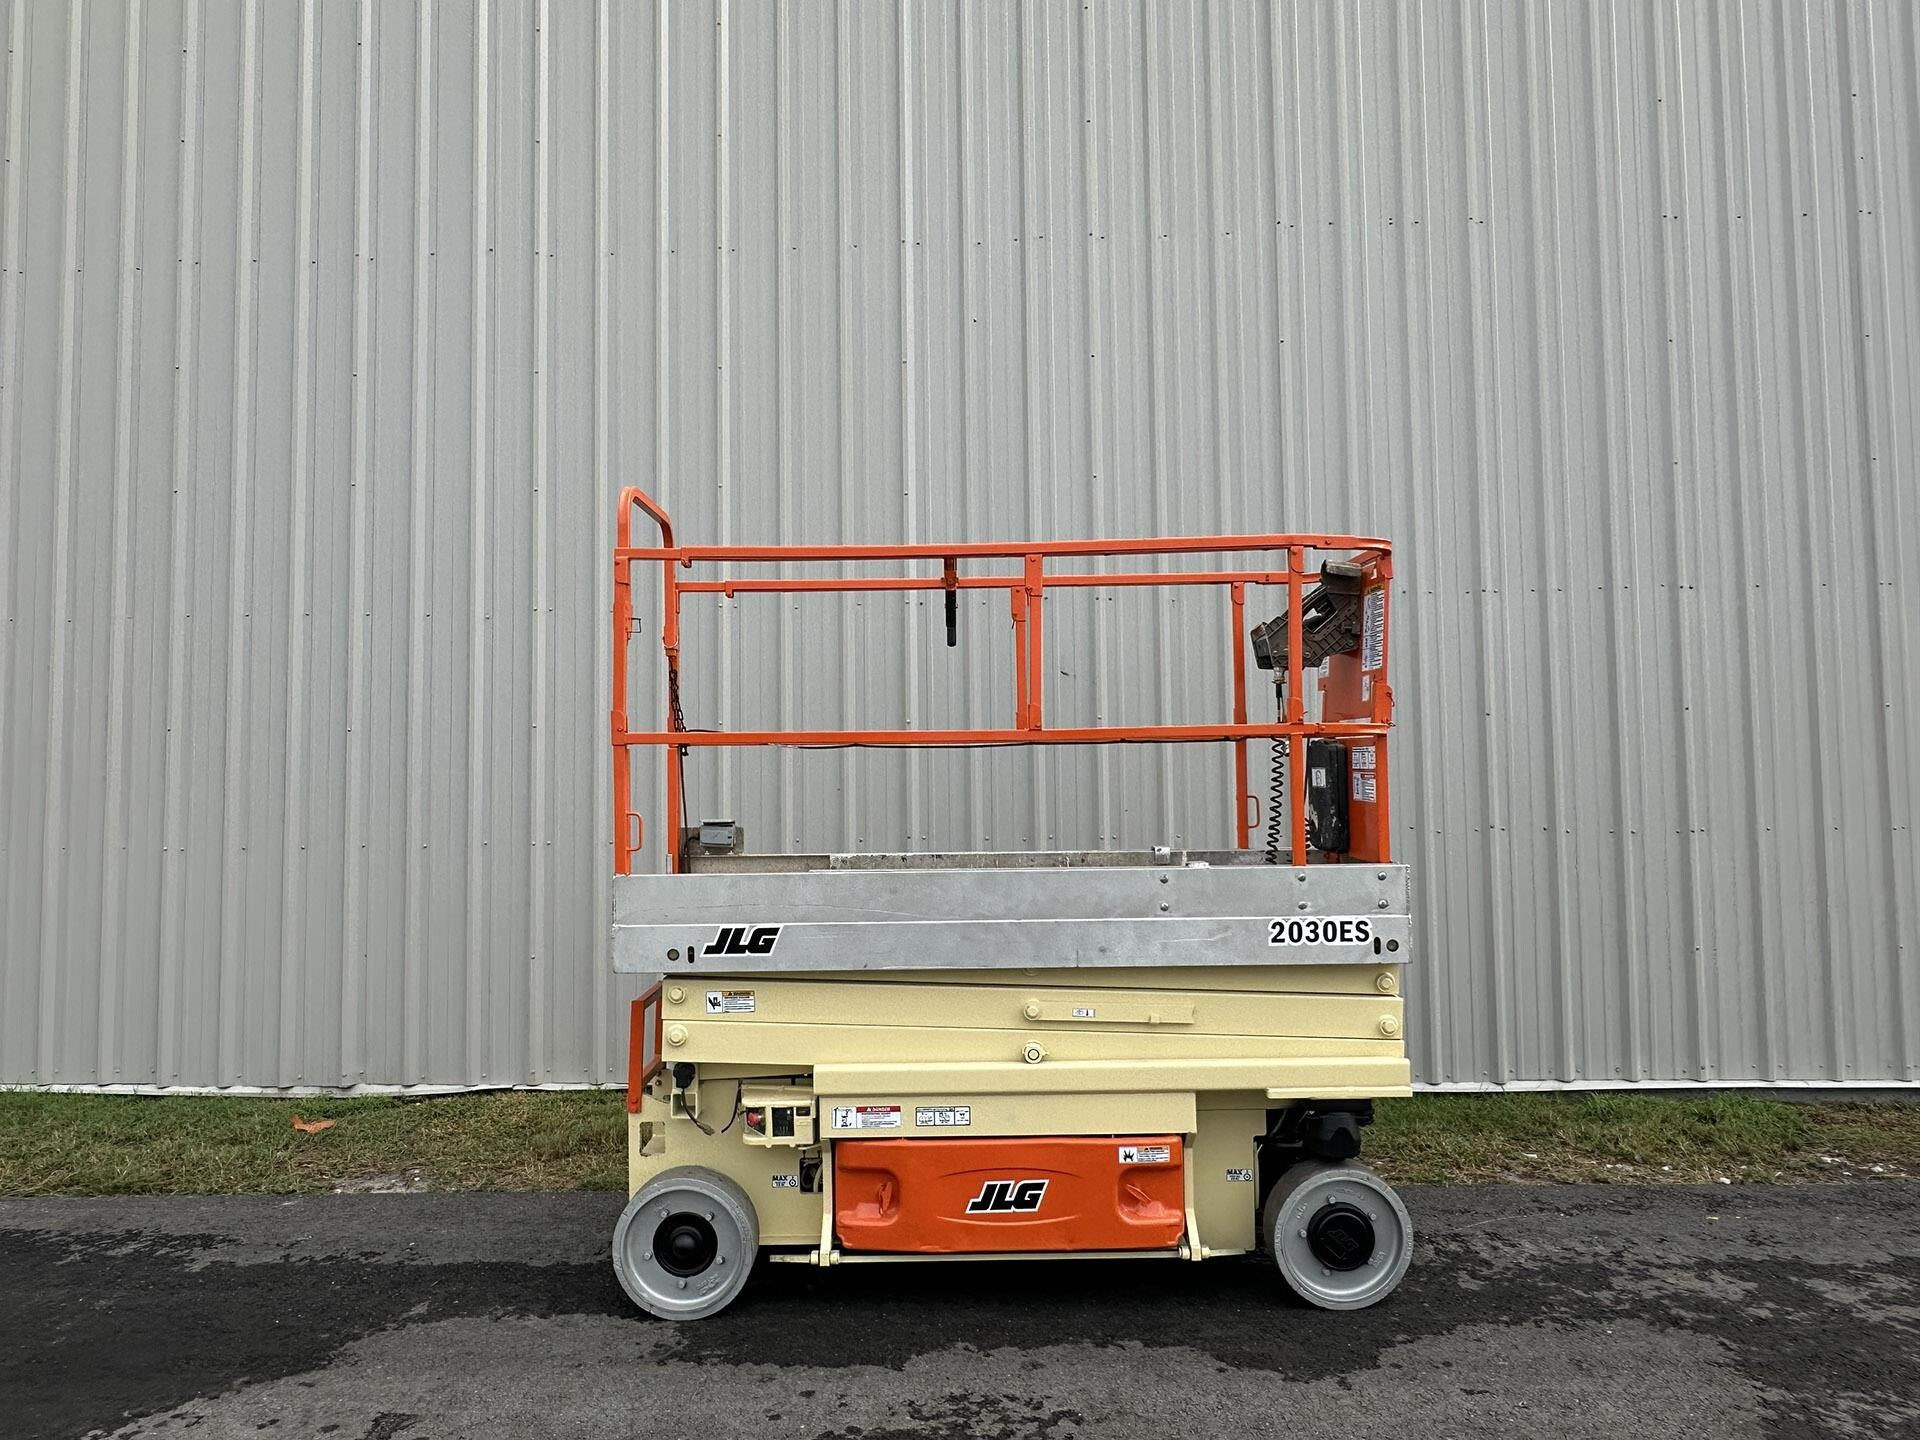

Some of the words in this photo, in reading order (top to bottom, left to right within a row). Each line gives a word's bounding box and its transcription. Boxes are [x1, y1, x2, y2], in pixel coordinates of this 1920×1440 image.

[703, 927, 781, 955] JLG
[1270, 920, 1370, 943] 2030ES
[968, 1182, 1047, 1212] JLG
